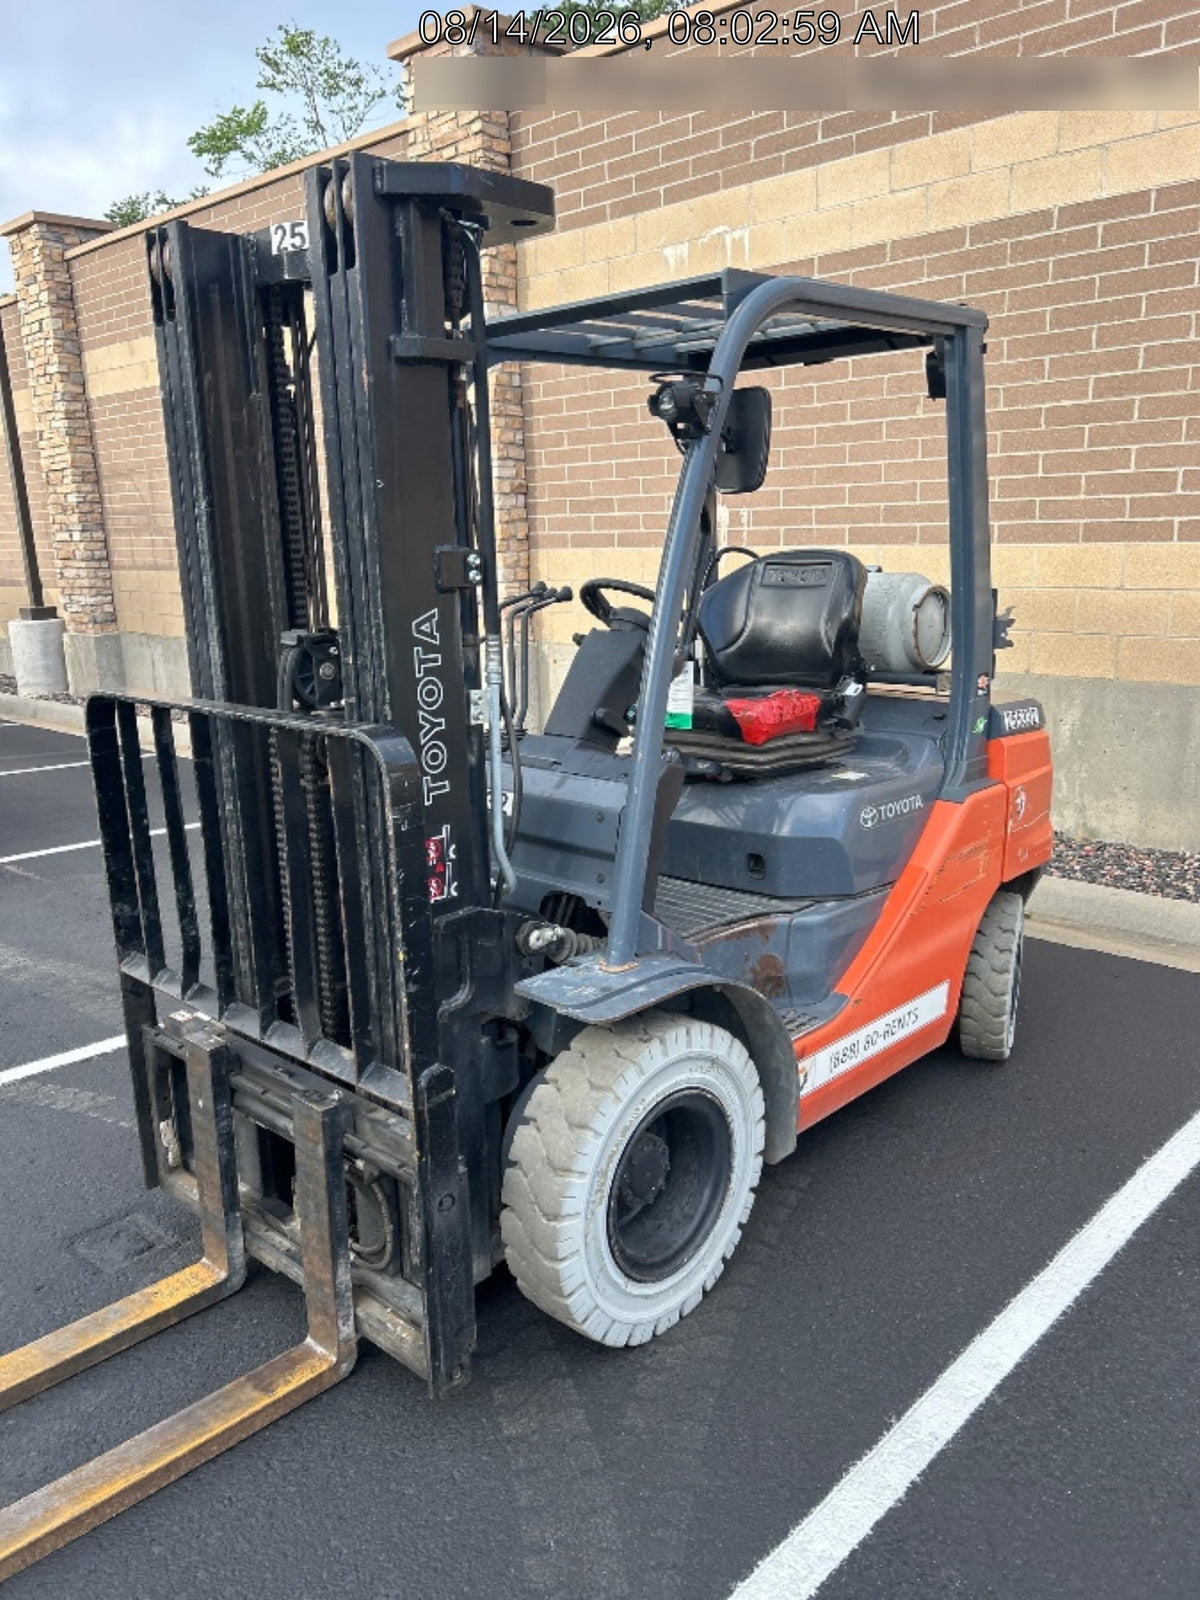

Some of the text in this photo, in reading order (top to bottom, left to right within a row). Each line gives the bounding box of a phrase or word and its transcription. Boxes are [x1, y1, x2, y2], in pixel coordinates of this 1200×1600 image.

[274, 222, 306, 252] 25
[412, 608, 450, 806] TOYOTA
[879, 794, 924, 820] TOYOTA
